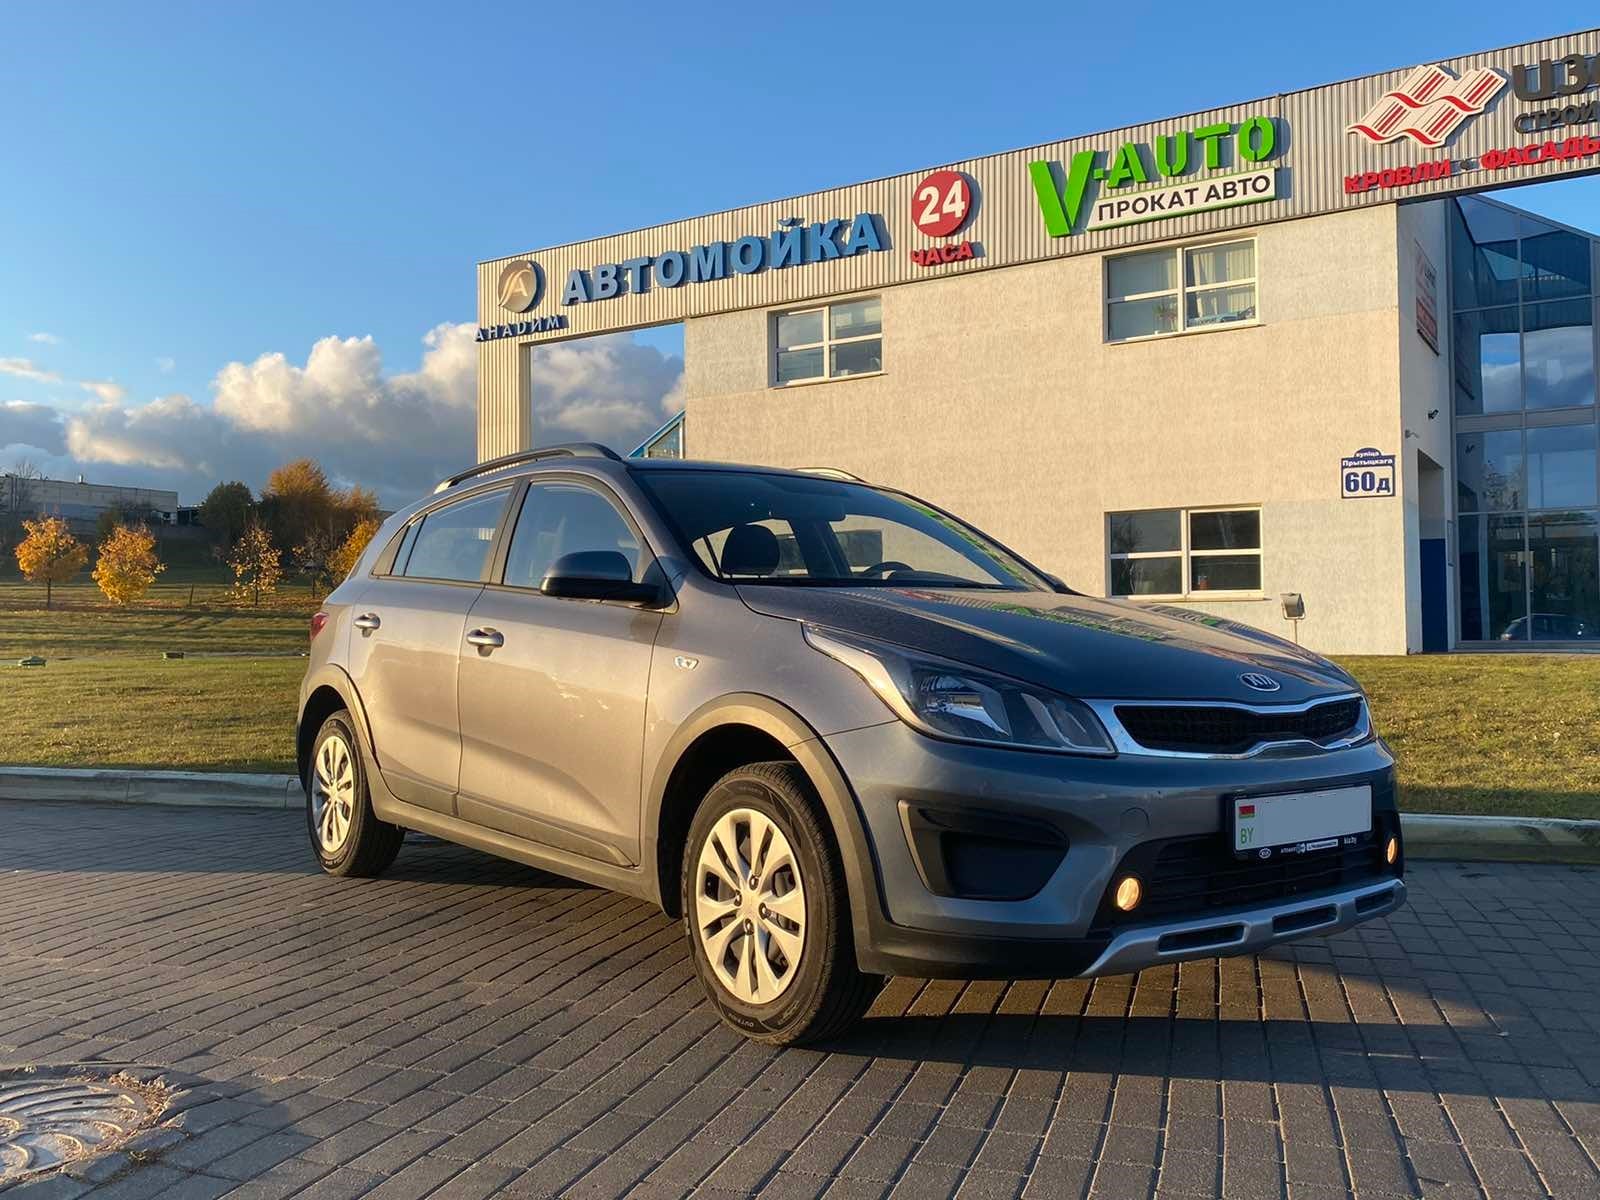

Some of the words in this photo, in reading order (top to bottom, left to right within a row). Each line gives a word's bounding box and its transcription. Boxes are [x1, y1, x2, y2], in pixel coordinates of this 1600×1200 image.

[1028, 115, 1276, 238] V-AUTO
[1098, 187, 1199, 221] ПРОКАТ
[1204, 174, 1271, 203] АВТО
[1344, 158, 1450, 194] КРОВЛИ
[918, 179, 966, 226] 24
[561, 212, 881, 306] АВТОМОЙКА
[911, 240, 974, 267] ЧАСА
[1240, 827, 1254, 844] BY
